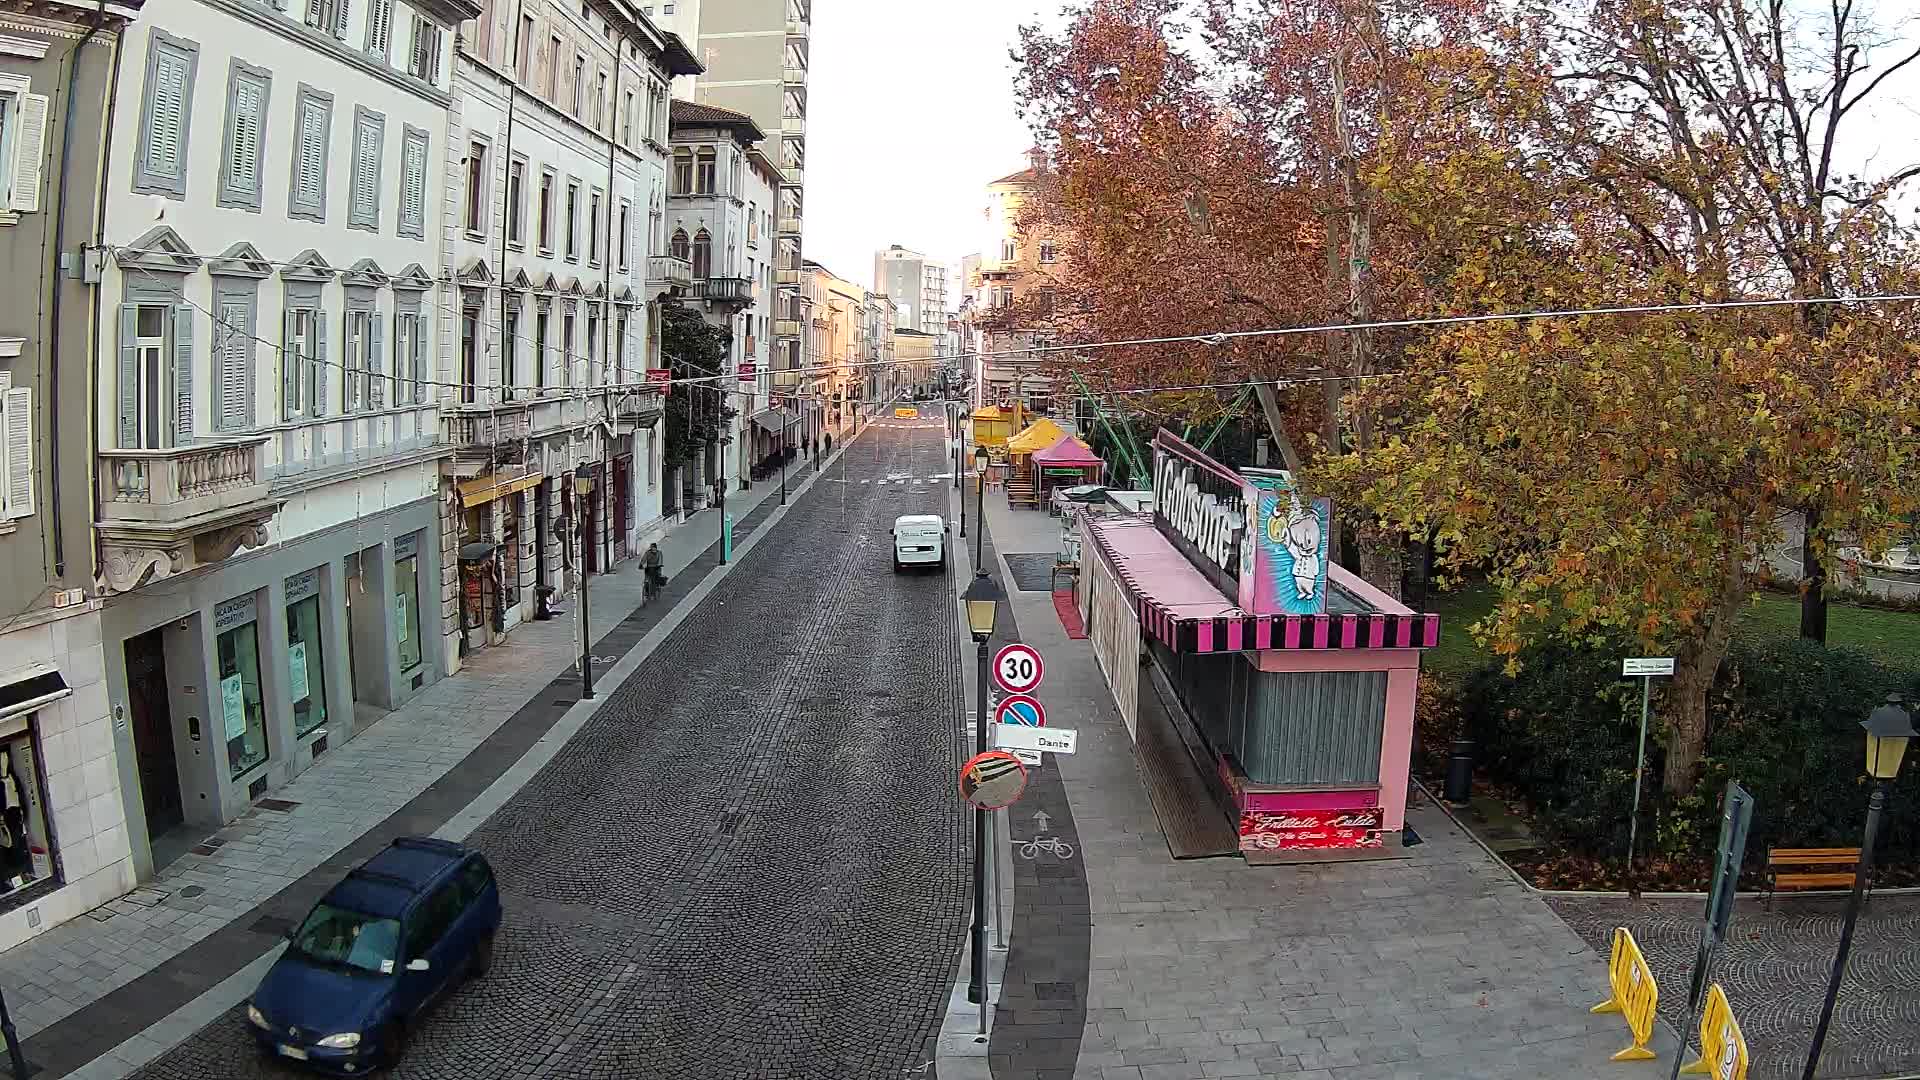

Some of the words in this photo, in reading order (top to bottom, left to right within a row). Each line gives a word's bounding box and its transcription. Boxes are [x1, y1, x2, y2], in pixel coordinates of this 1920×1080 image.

[1162, 458, 1233, 570] Golosone
[1005, 658, 1033, 680] 30
[1038, 737, 1070, 748] Dante
